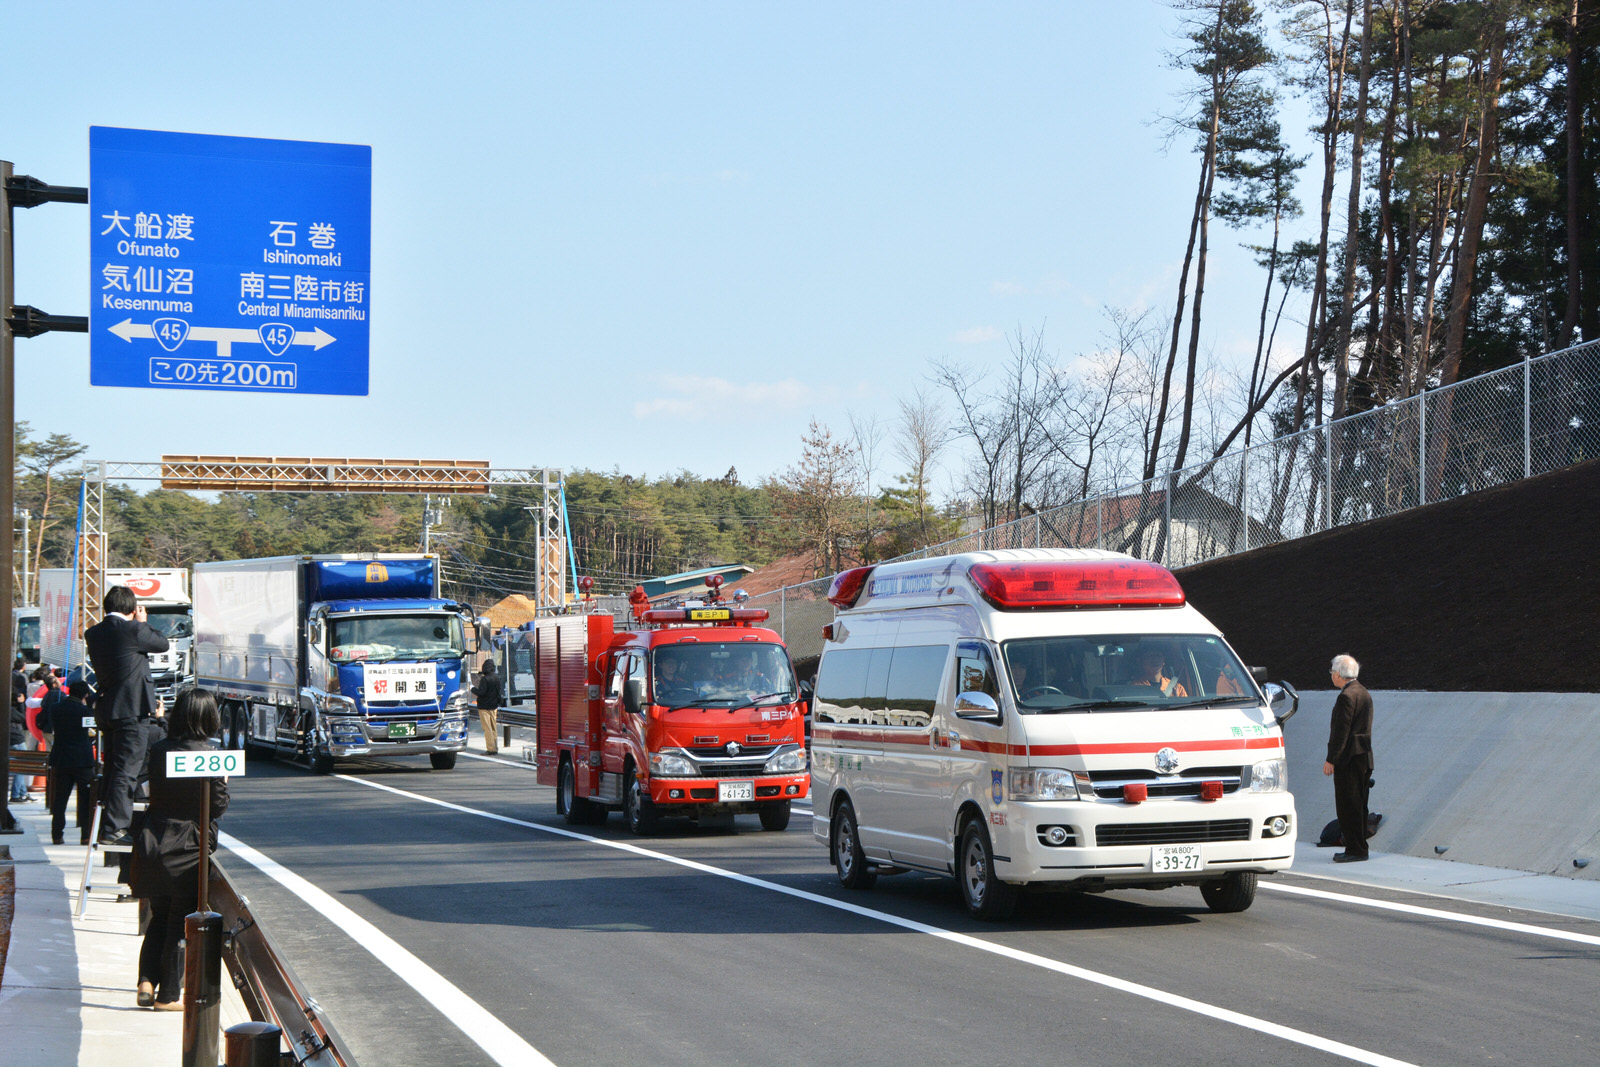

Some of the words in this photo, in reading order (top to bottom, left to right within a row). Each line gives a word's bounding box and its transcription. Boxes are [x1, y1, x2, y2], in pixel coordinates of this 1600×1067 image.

[101, 210, 195, 241] 大船渡
[269, 220, 336, 250] 石巻
[117, 240, 180, 258] Ofunato
[263, 249, 342, 267] Ishinomaki
[102, 263, 194, 295] 気仙沼
[240, 272, 364, 304] 南三陸市街
[102, 294, 193, 313] Kesennuma
[238, 301, 280, 317] Central
[283, 303, 366, 321] Minamisanriku
[160, 323, 182, 341] 45
[266, 328, 288, 346] 45
[154, 362, 294, 386] この先200m
[174, 756, 187, 772] E
[194, 755, 237, 772] 280
[727, 789, 751, 798] 61-23
[1163, 855, 1199, 870] 39-27
